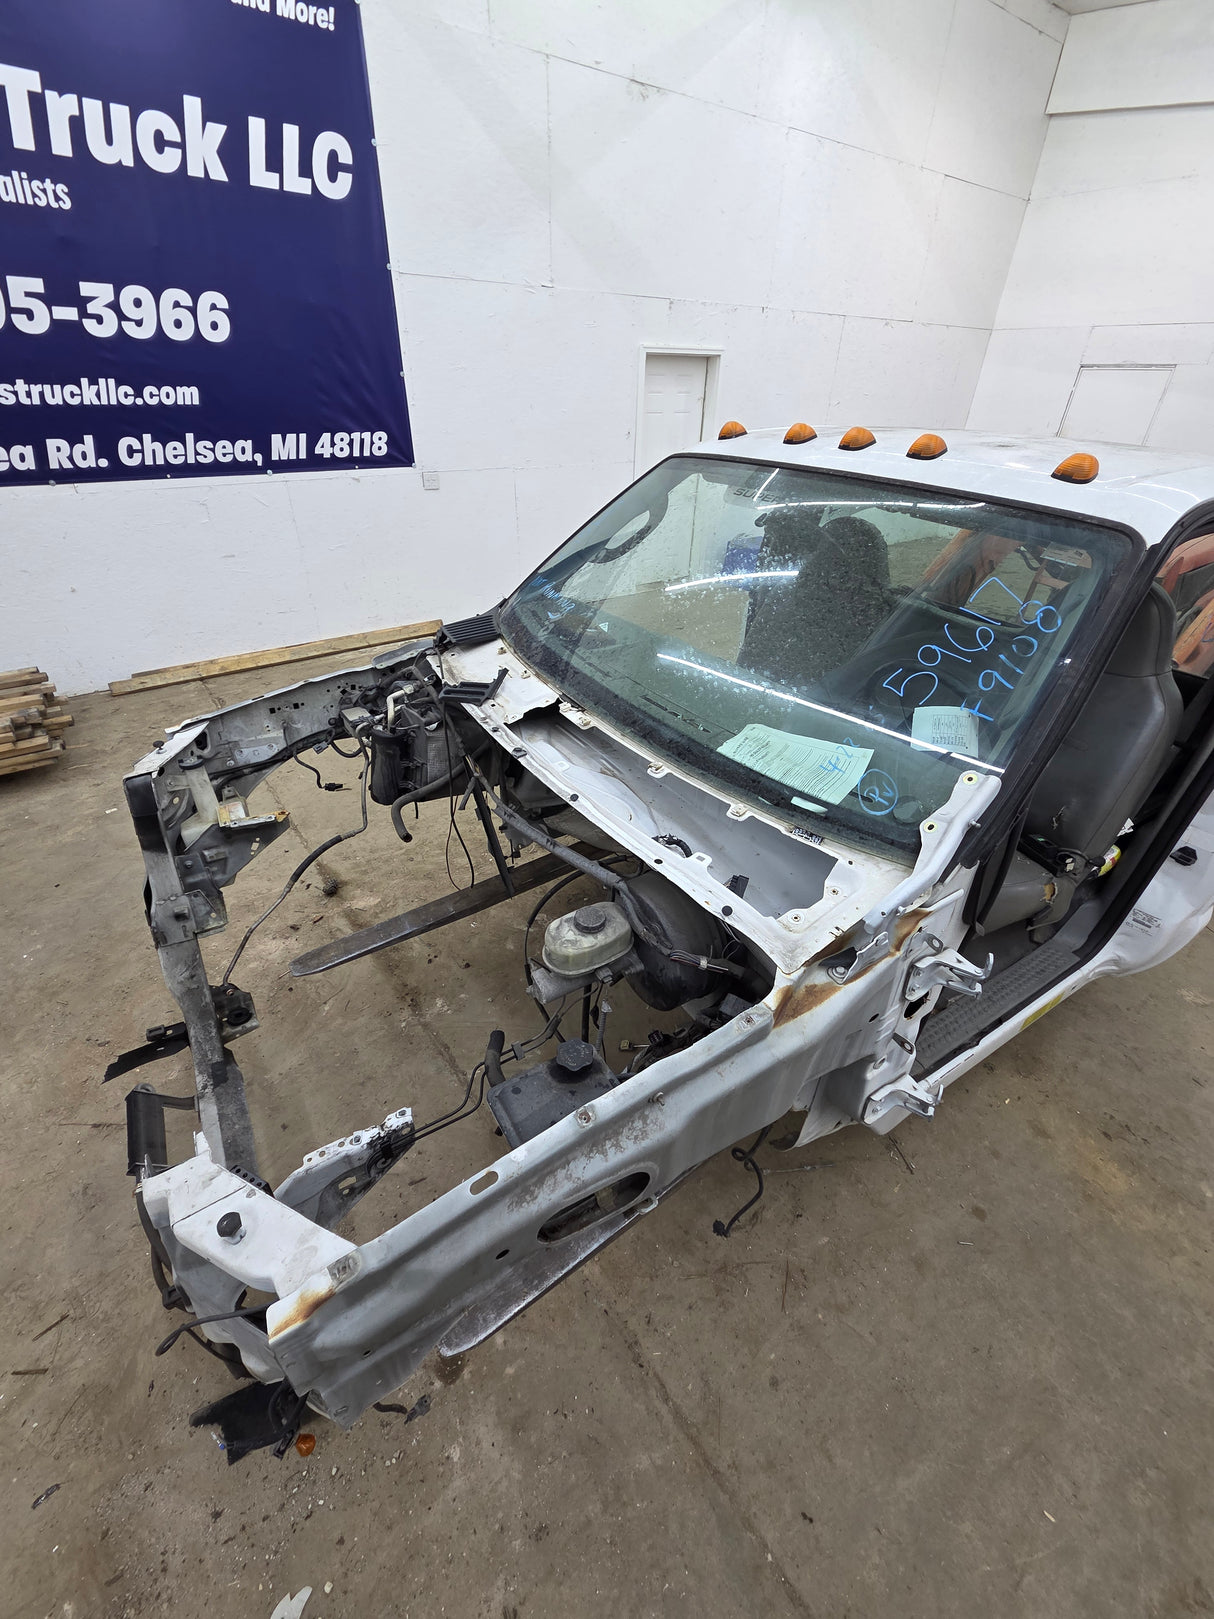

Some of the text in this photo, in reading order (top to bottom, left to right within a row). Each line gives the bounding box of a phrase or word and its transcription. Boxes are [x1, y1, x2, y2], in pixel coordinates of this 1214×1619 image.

[276, 0, 335, 31] More!
[0, 63, 354, 200] Truck LLC
[0, 275, 231, 343] 5-3966
[0, 377, 200, 405] struckllc.com
[46, 434, 109, 470] Rd.
[117, 432, 263, 466] Chelsea,
[271, 433, 306, 460] MI
[315, 431, 388, 459] 48118
[882, 576, 1023, 705] 59617
